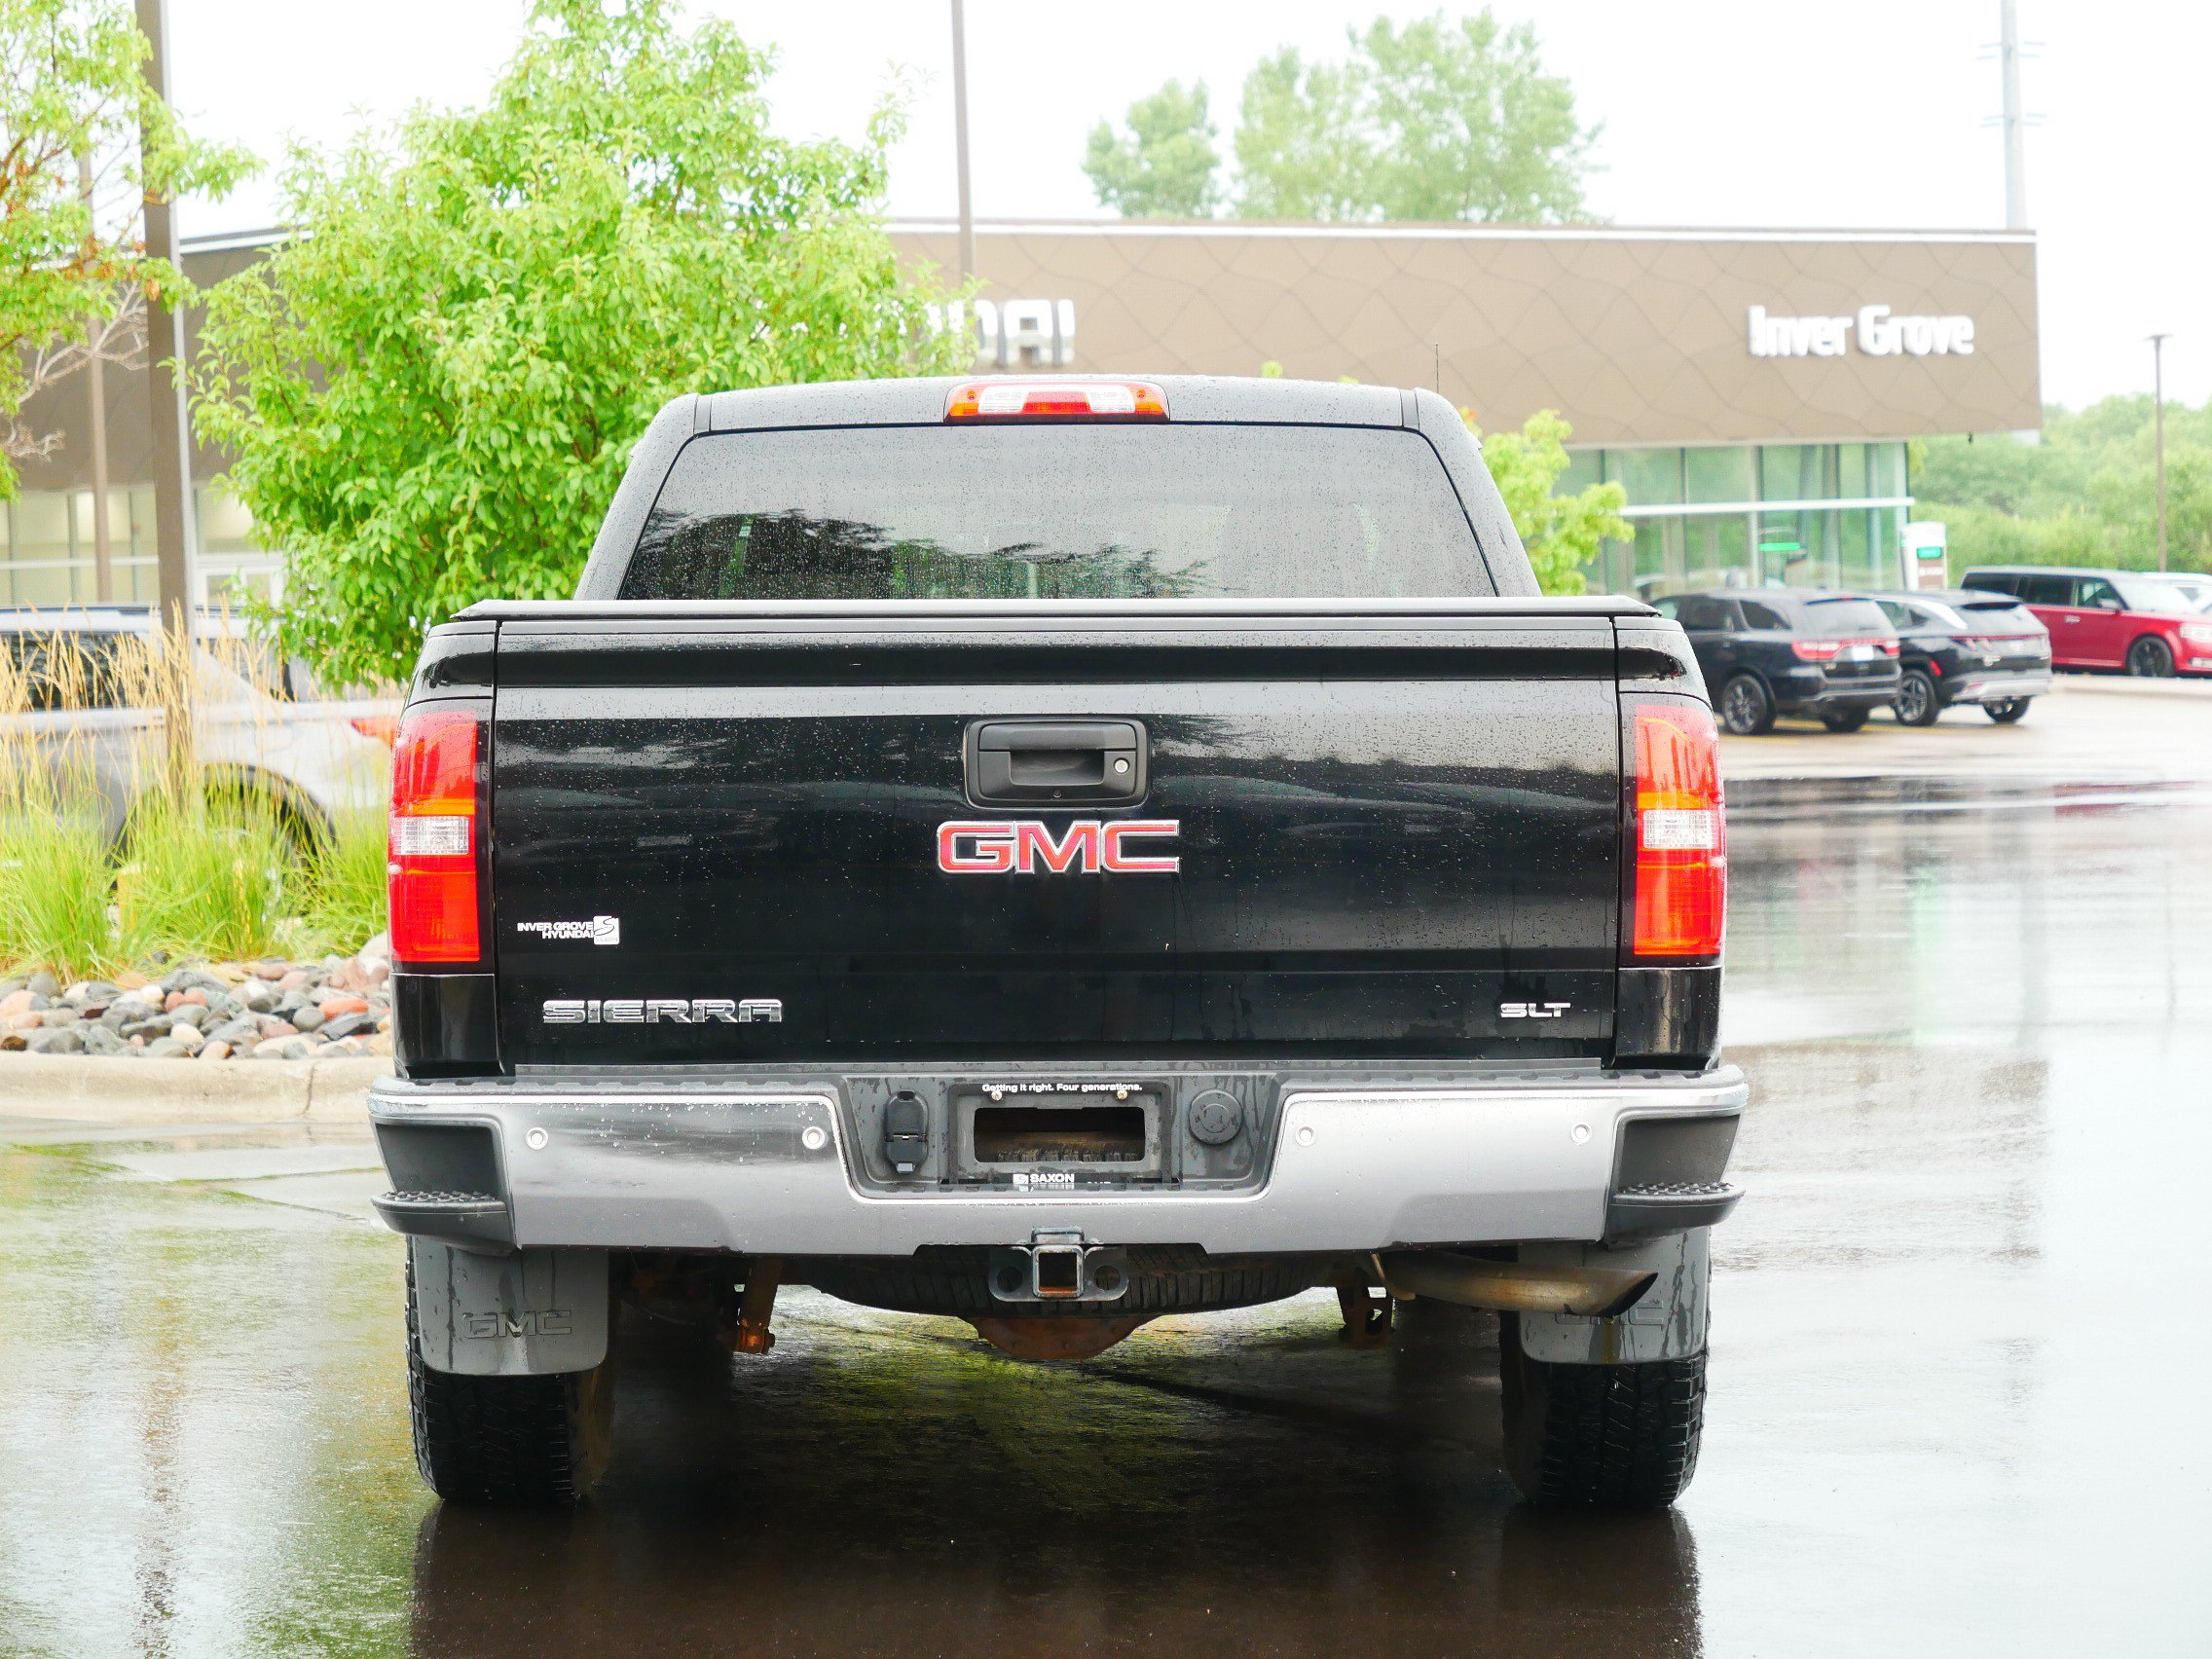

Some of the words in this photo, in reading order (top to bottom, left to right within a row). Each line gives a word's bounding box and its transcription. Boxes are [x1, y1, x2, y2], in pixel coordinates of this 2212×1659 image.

[1748, 304, 1854, 357] Inver
[1857, 304, 1975, 357] Grove
[937, 819, 1180, 874] GMC
[517, 922, 552, 932] INVER
[552, 921, 594, 931] GROVE
[541, 930, 594, 940] HYUNDAI
[542, 999, 783, 1023] SIERRA
[1500, 1002, 1571, 1018] SLT
[981, 1083, 1018, 1093] Getting
[1028, 1083, 1054, 1093] right.
[1056, 1083, 1080, 1091] Four
[1081, 1083, 1143, 1092] generations.
[1029, 1173, 1075, 1184] SAXON
[462, 1310, 572, 1338] GMC
